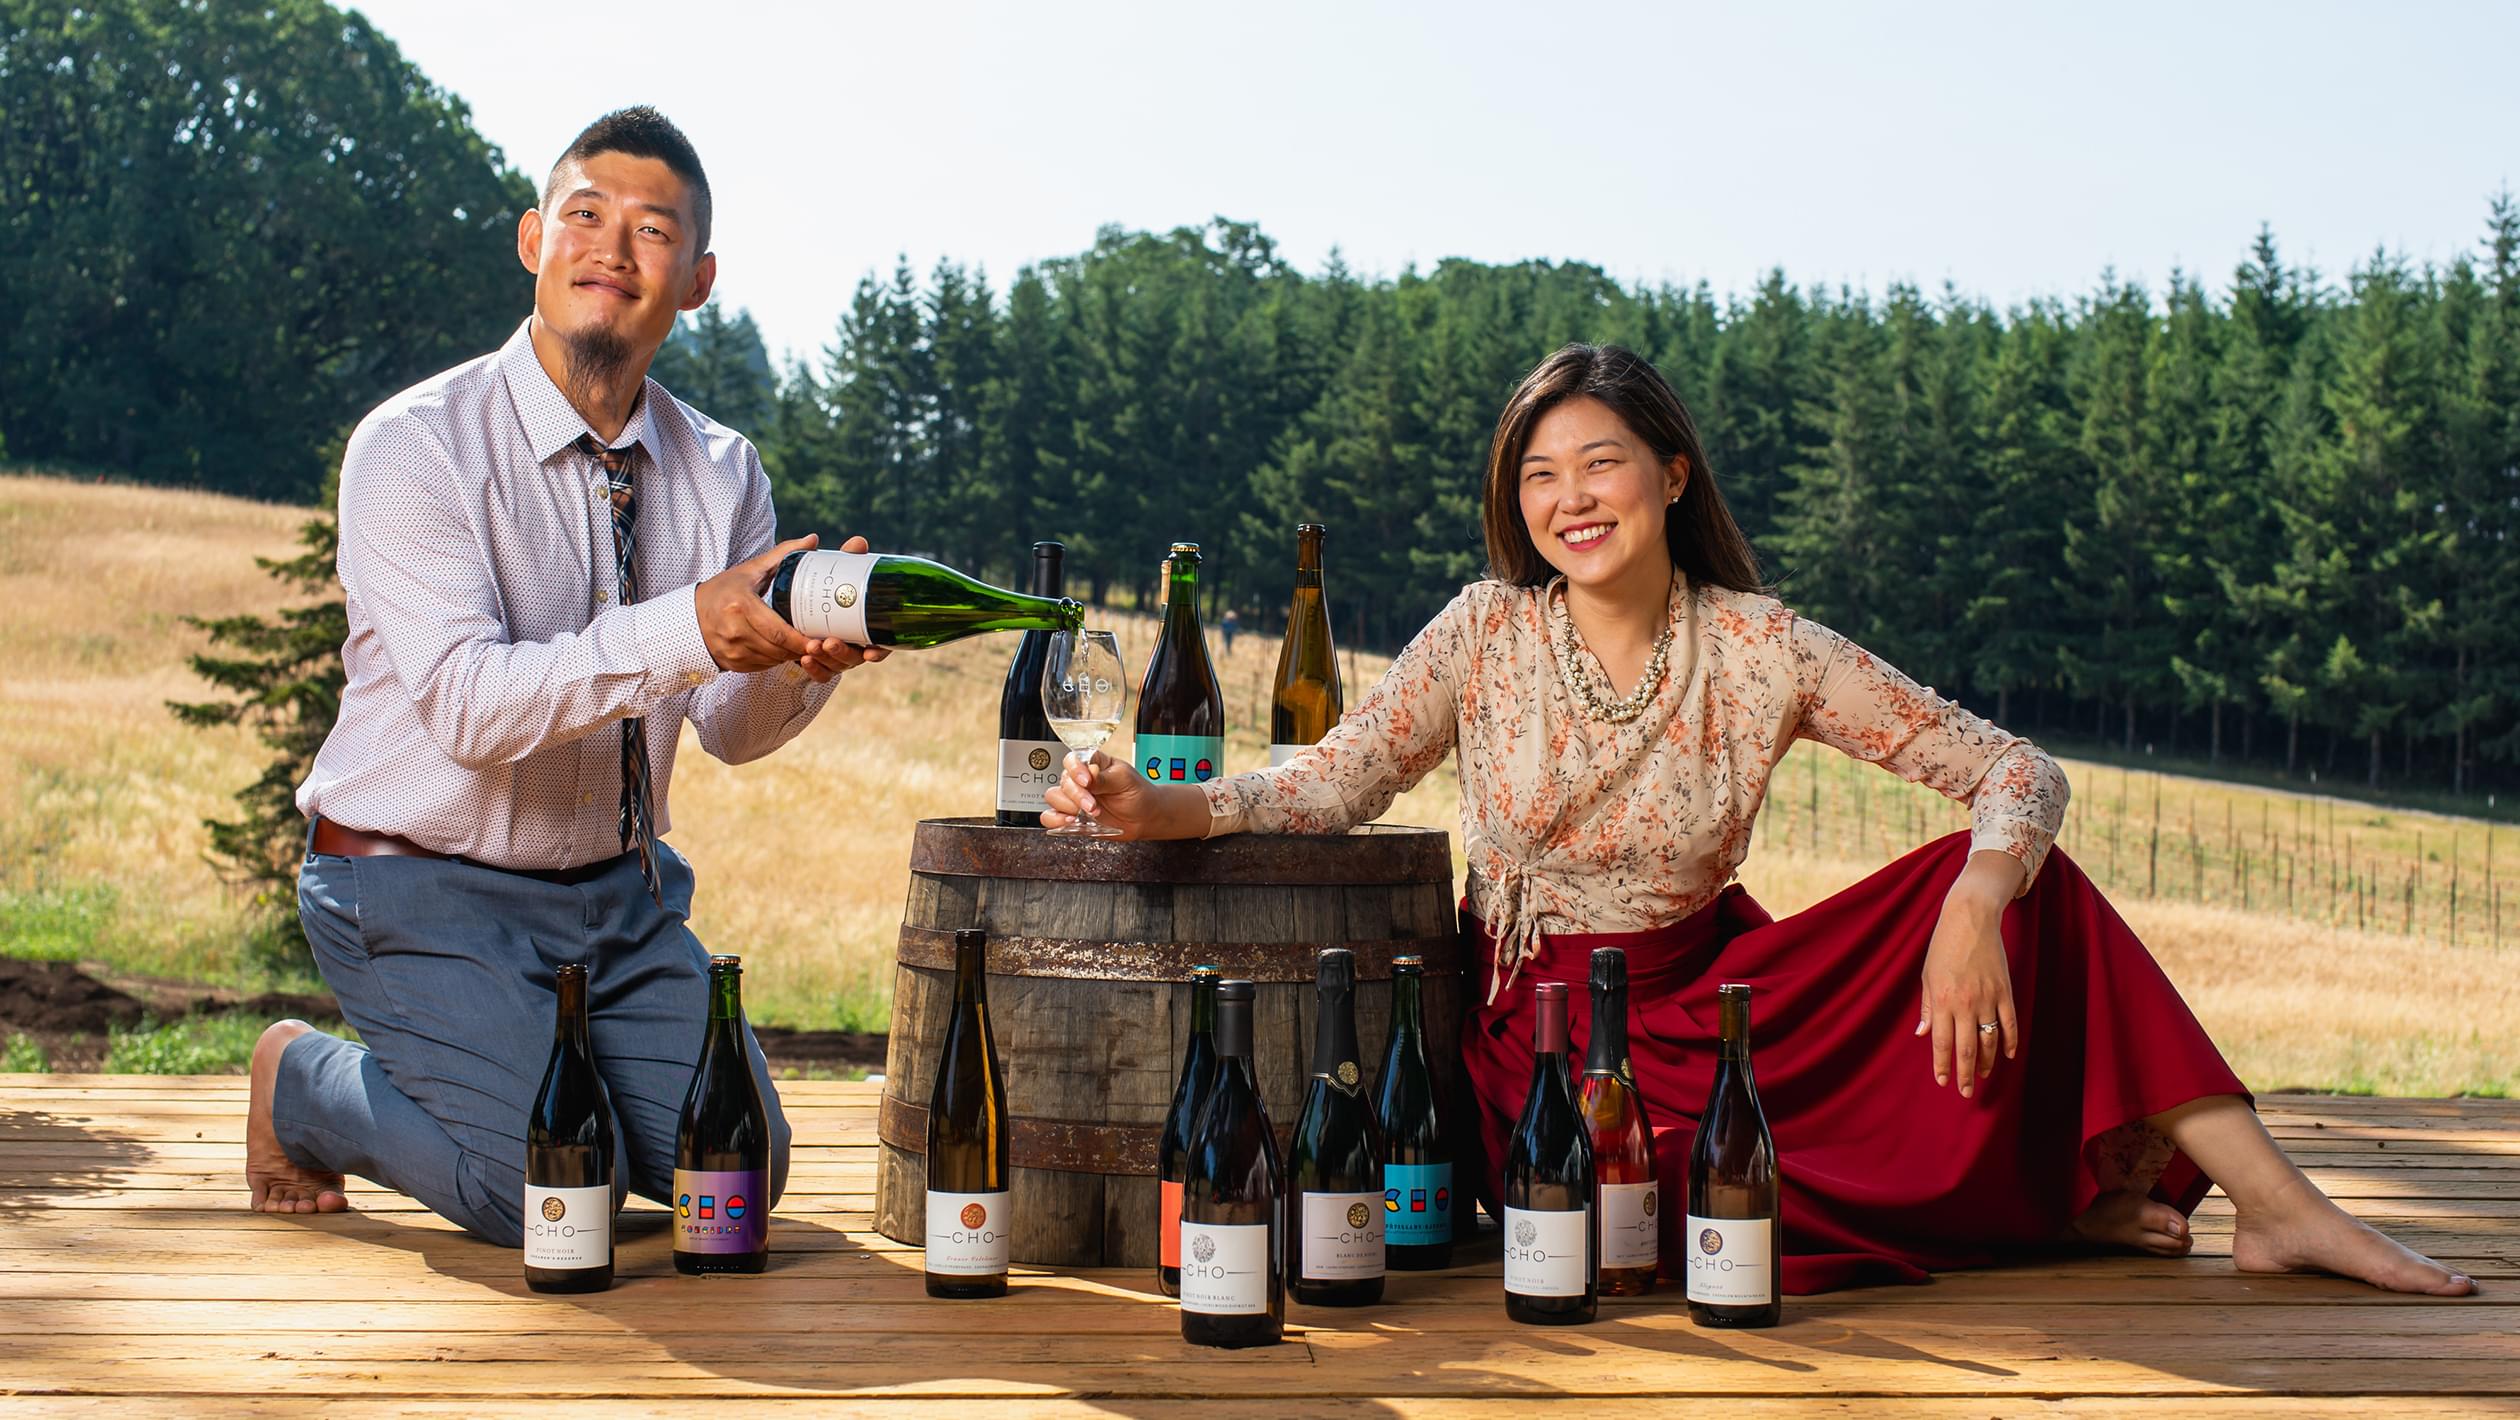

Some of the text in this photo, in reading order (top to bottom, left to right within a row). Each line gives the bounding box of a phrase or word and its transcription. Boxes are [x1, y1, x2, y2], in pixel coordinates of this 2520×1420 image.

[821, 575, 834, 614] CHO
[1146, 757, 1212, 782] CHO
[1020, 773, 1058, 784] CHO
[680, 1194, 747, 1219] CHO
[534, 1224, 575, 1237] CHO
[952, 1231, 995, 1243] CHO
[1339, 1231, 1375, 1244] CHO
[1509, 1246, 1546, 1262] CHO
[1186, 1263, 1225, 1279] CHO
[1694, 1256, 1734, 1272] CHO
